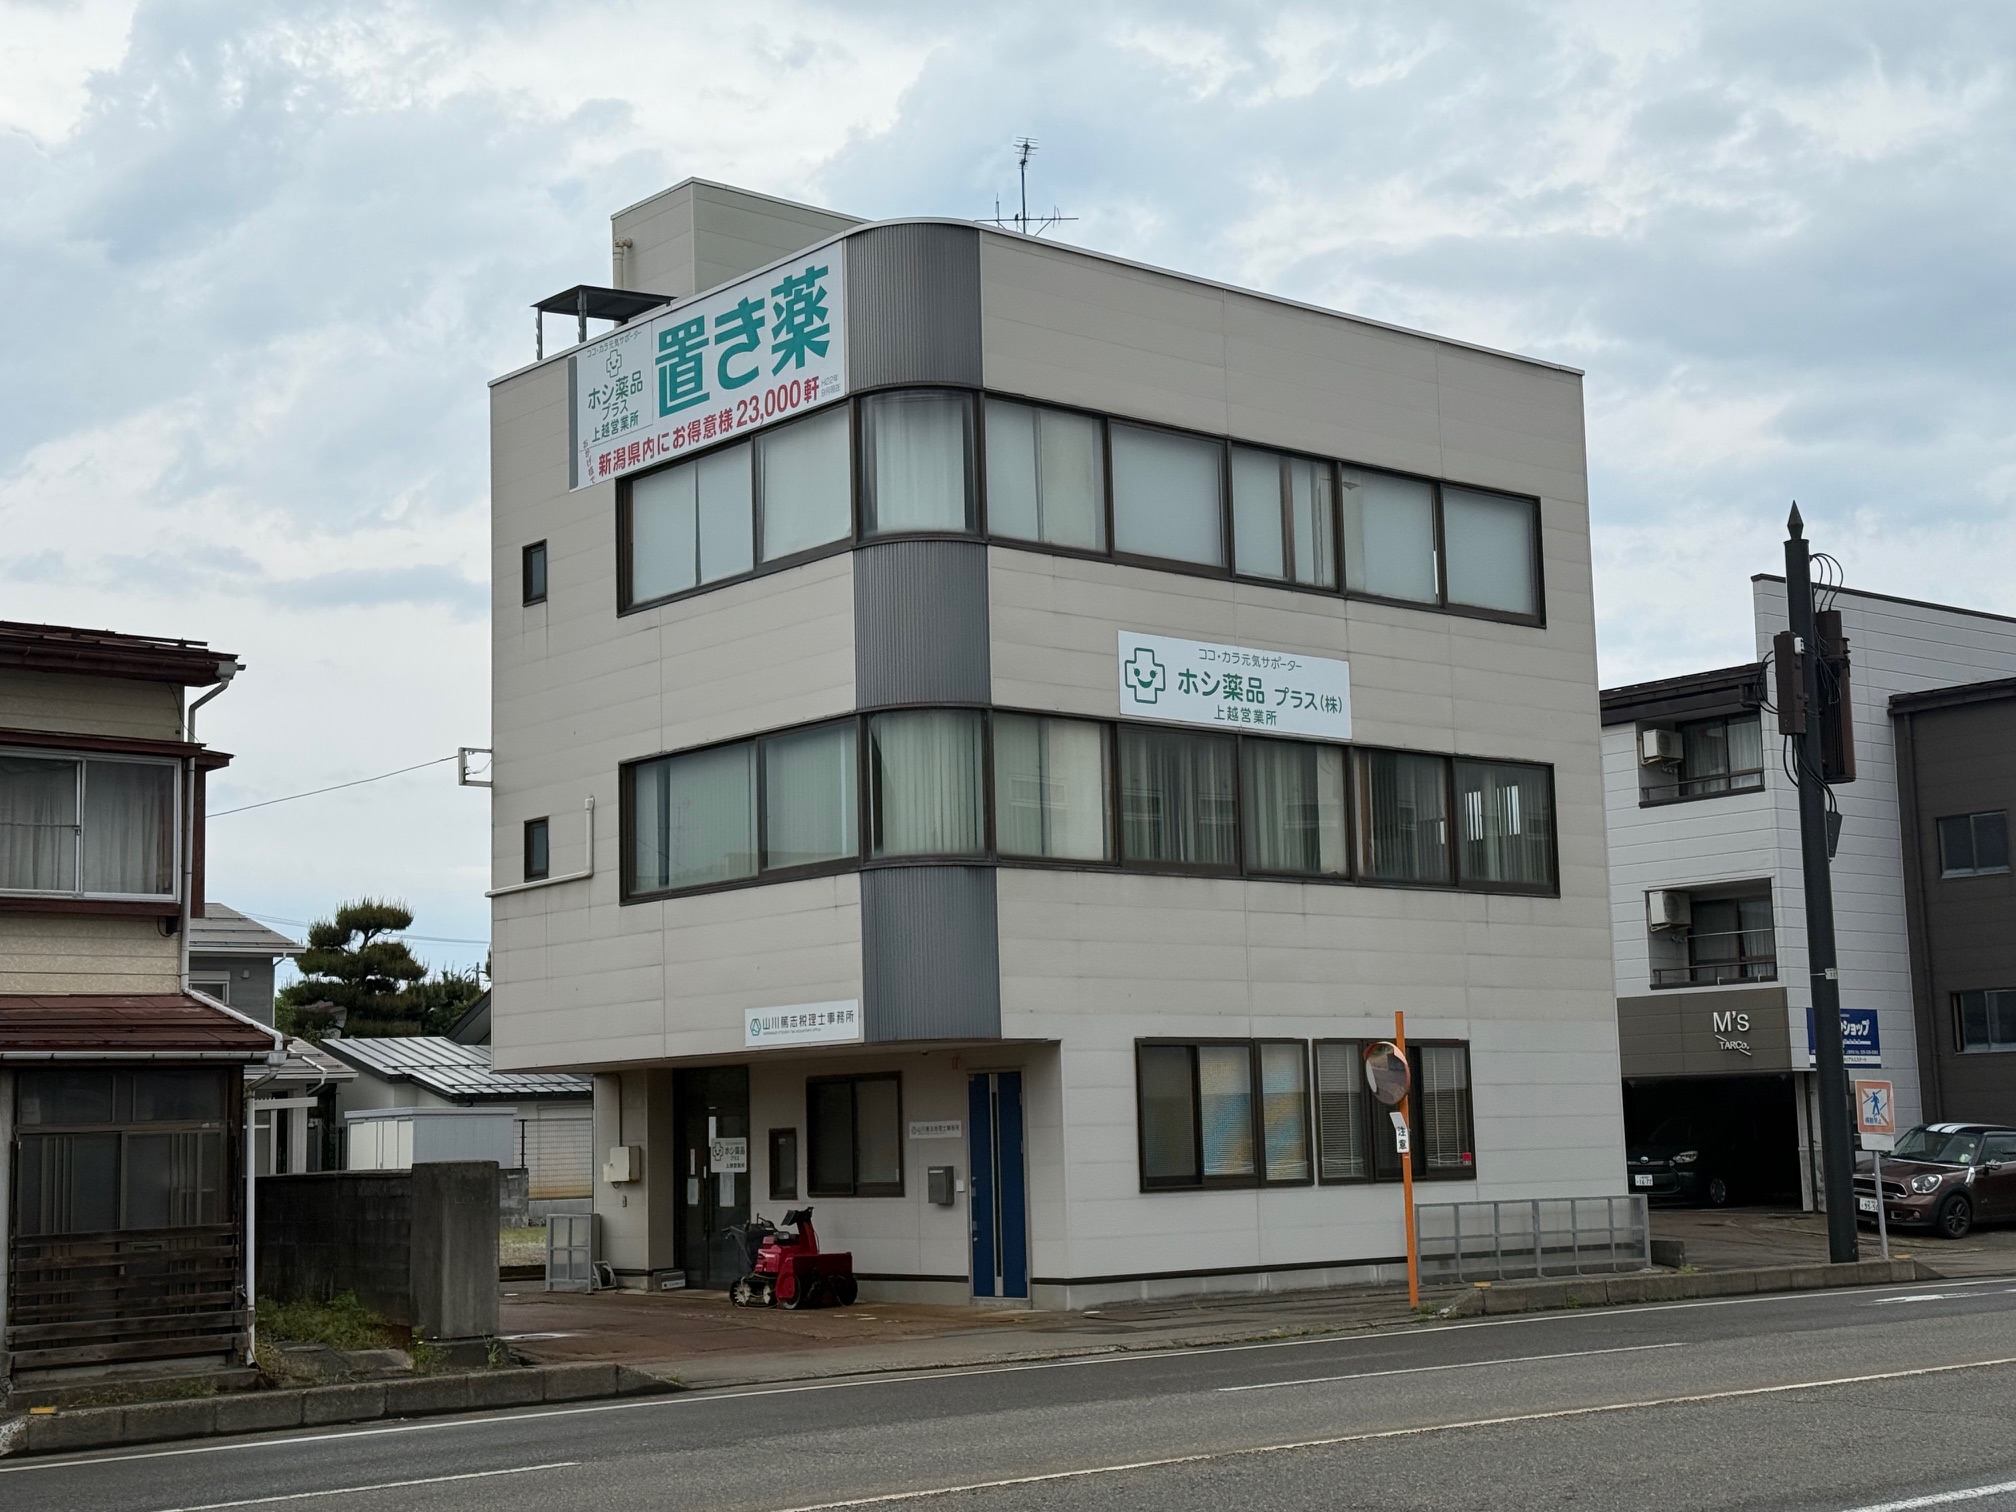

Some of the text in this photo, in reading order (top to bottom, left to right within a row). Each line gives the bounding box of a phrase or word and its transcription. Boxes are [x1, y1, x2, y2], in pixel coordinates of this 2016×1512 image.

[655, 265, 830, 418] 置き薬
[588, 370, 644, 410] ホシ薬品
[602, 399, 629, 421] プラス
[592, 410, 639, 443] 上越営業所
[1198, 649, 1303, 672] ココ・カラ元気サポーター
[1178, 668, 1265, 704] ホシ薬品
[1214, 705, 1277, 726] 上越営業所
[1713, 1010, 1750, 1032] M's
[1841, 1019, 1870, 1036] ショップ
[1397, 1126, 1407, 1149] 注意
